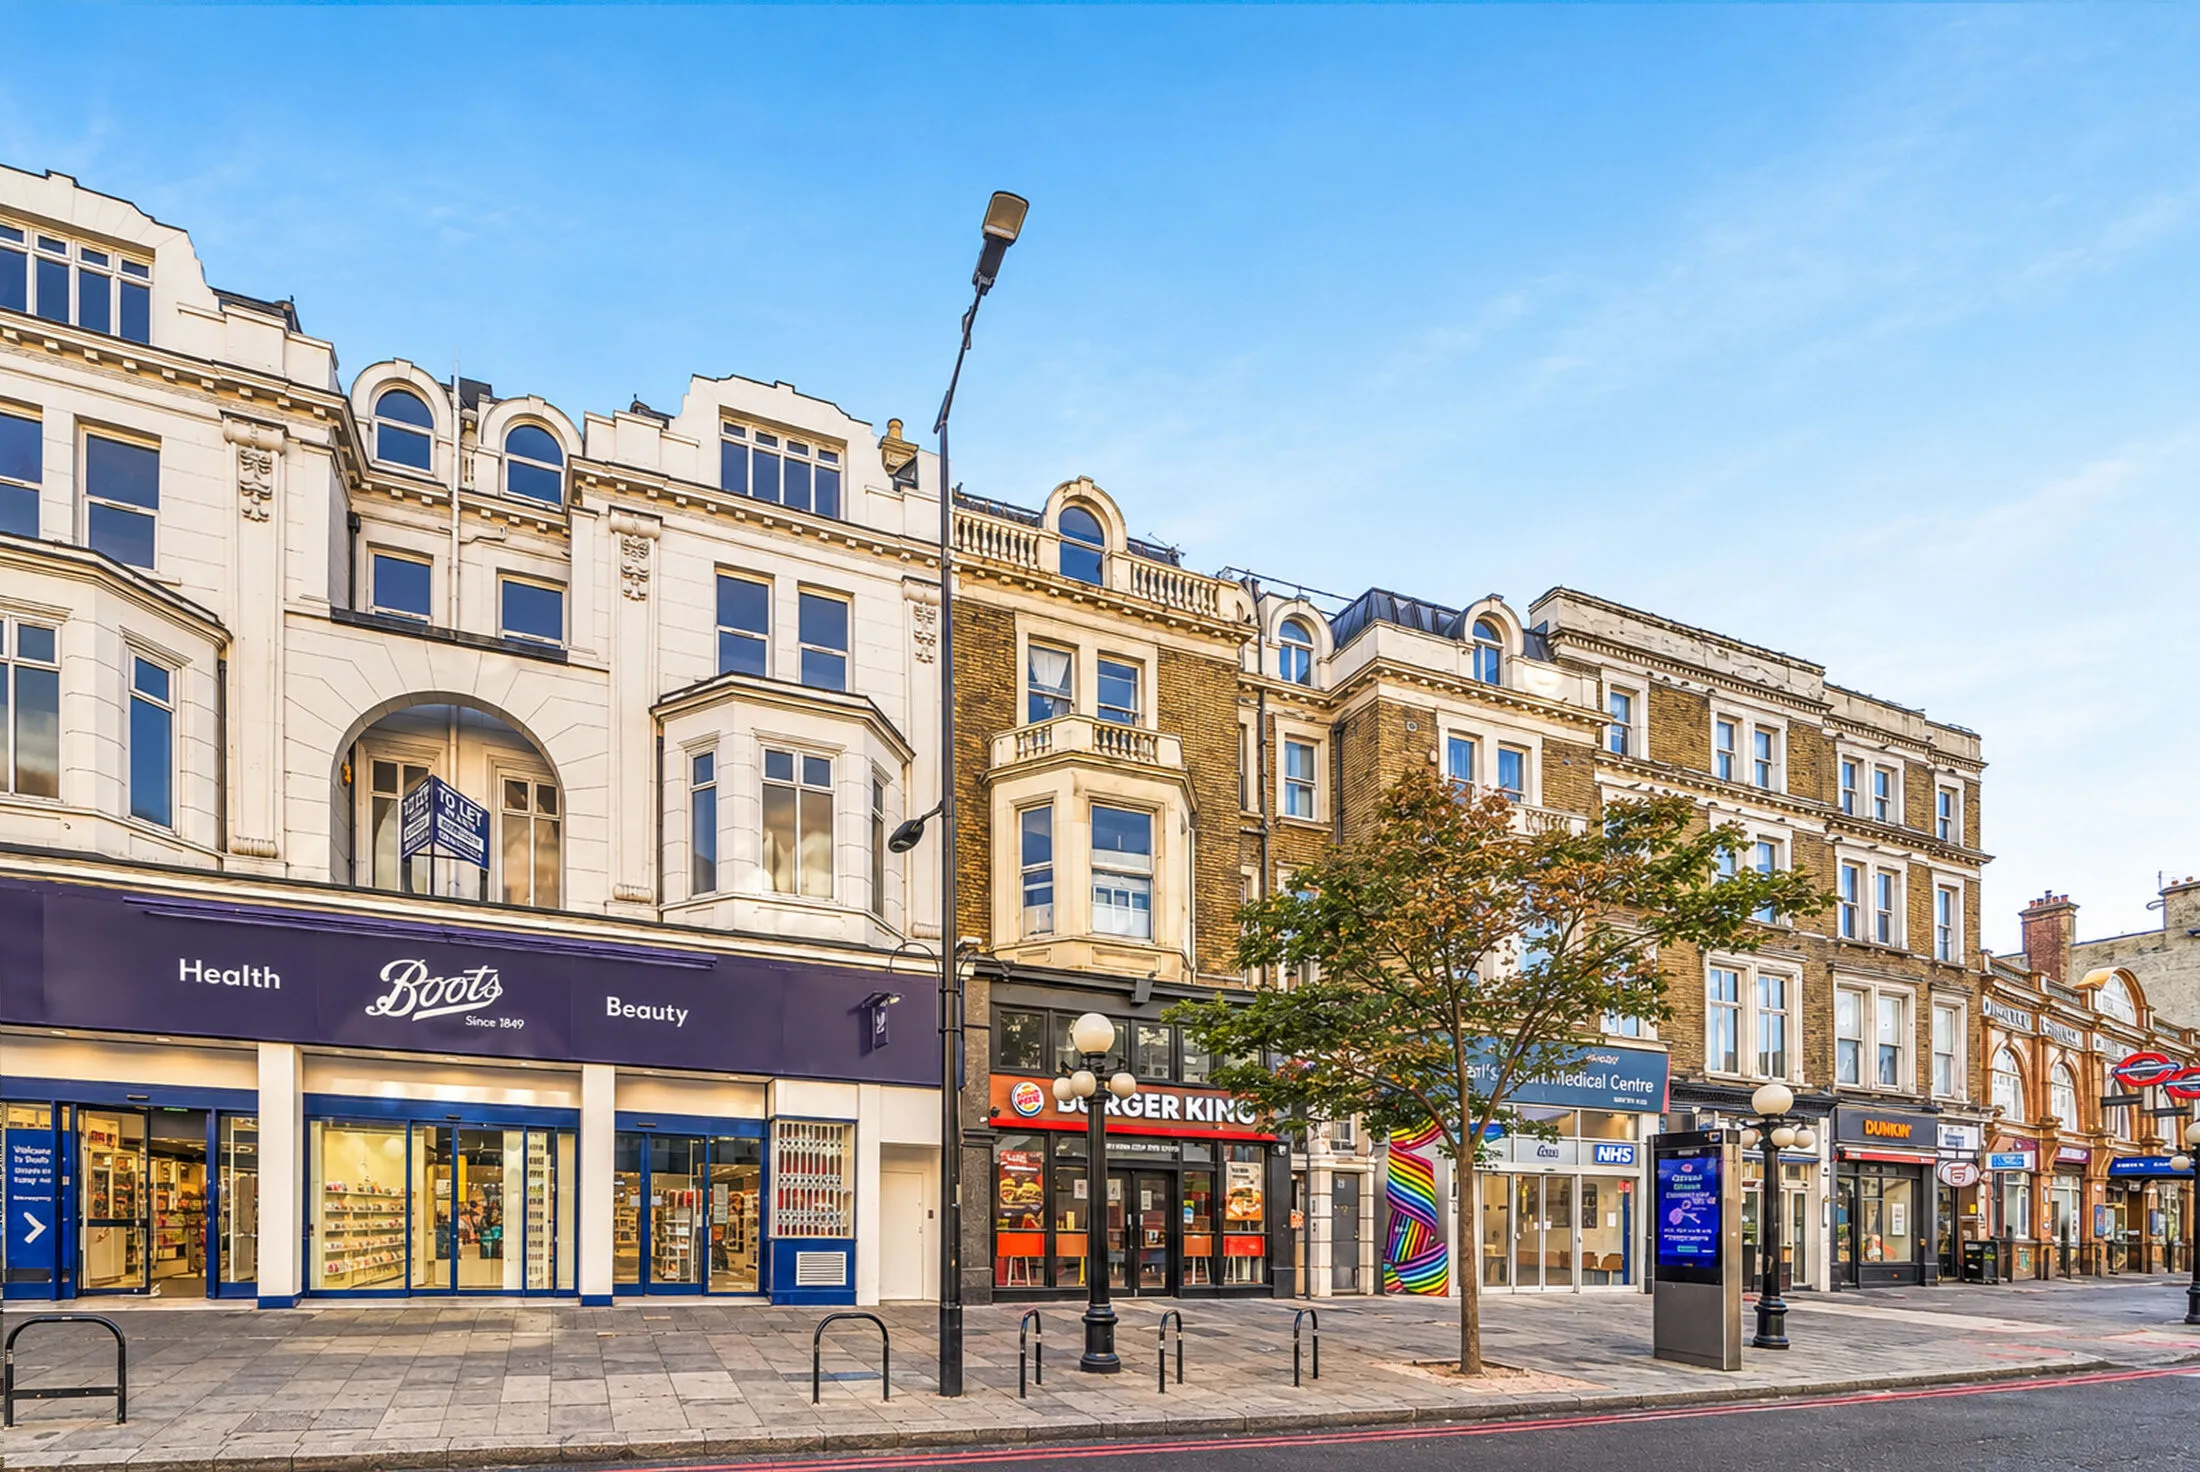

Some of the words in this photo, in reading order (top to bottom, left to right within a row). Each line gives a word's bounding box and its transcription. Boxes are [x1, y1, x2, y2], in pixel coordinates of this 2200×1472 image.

[437, 786, 456, 809] TO
[460, 801, 483, 827] LET
[179, 958, 281, 990] Health
[365, 958, 504, 1022] Boots
[465, 1015, 496, 1028] Since
[499, 1017, 525, 1030] 1849
[606, 996, 689, 1028] Beauty
[1463, 1060, 1500, 1082] arl's
[1551, 1068, 1607, 1090] Medical
[1610, 1074, 1655, 1094] Centre
[1184, 1095, 1257, 1125] KING
[1597, 1145, 1633, 1163] NHS
